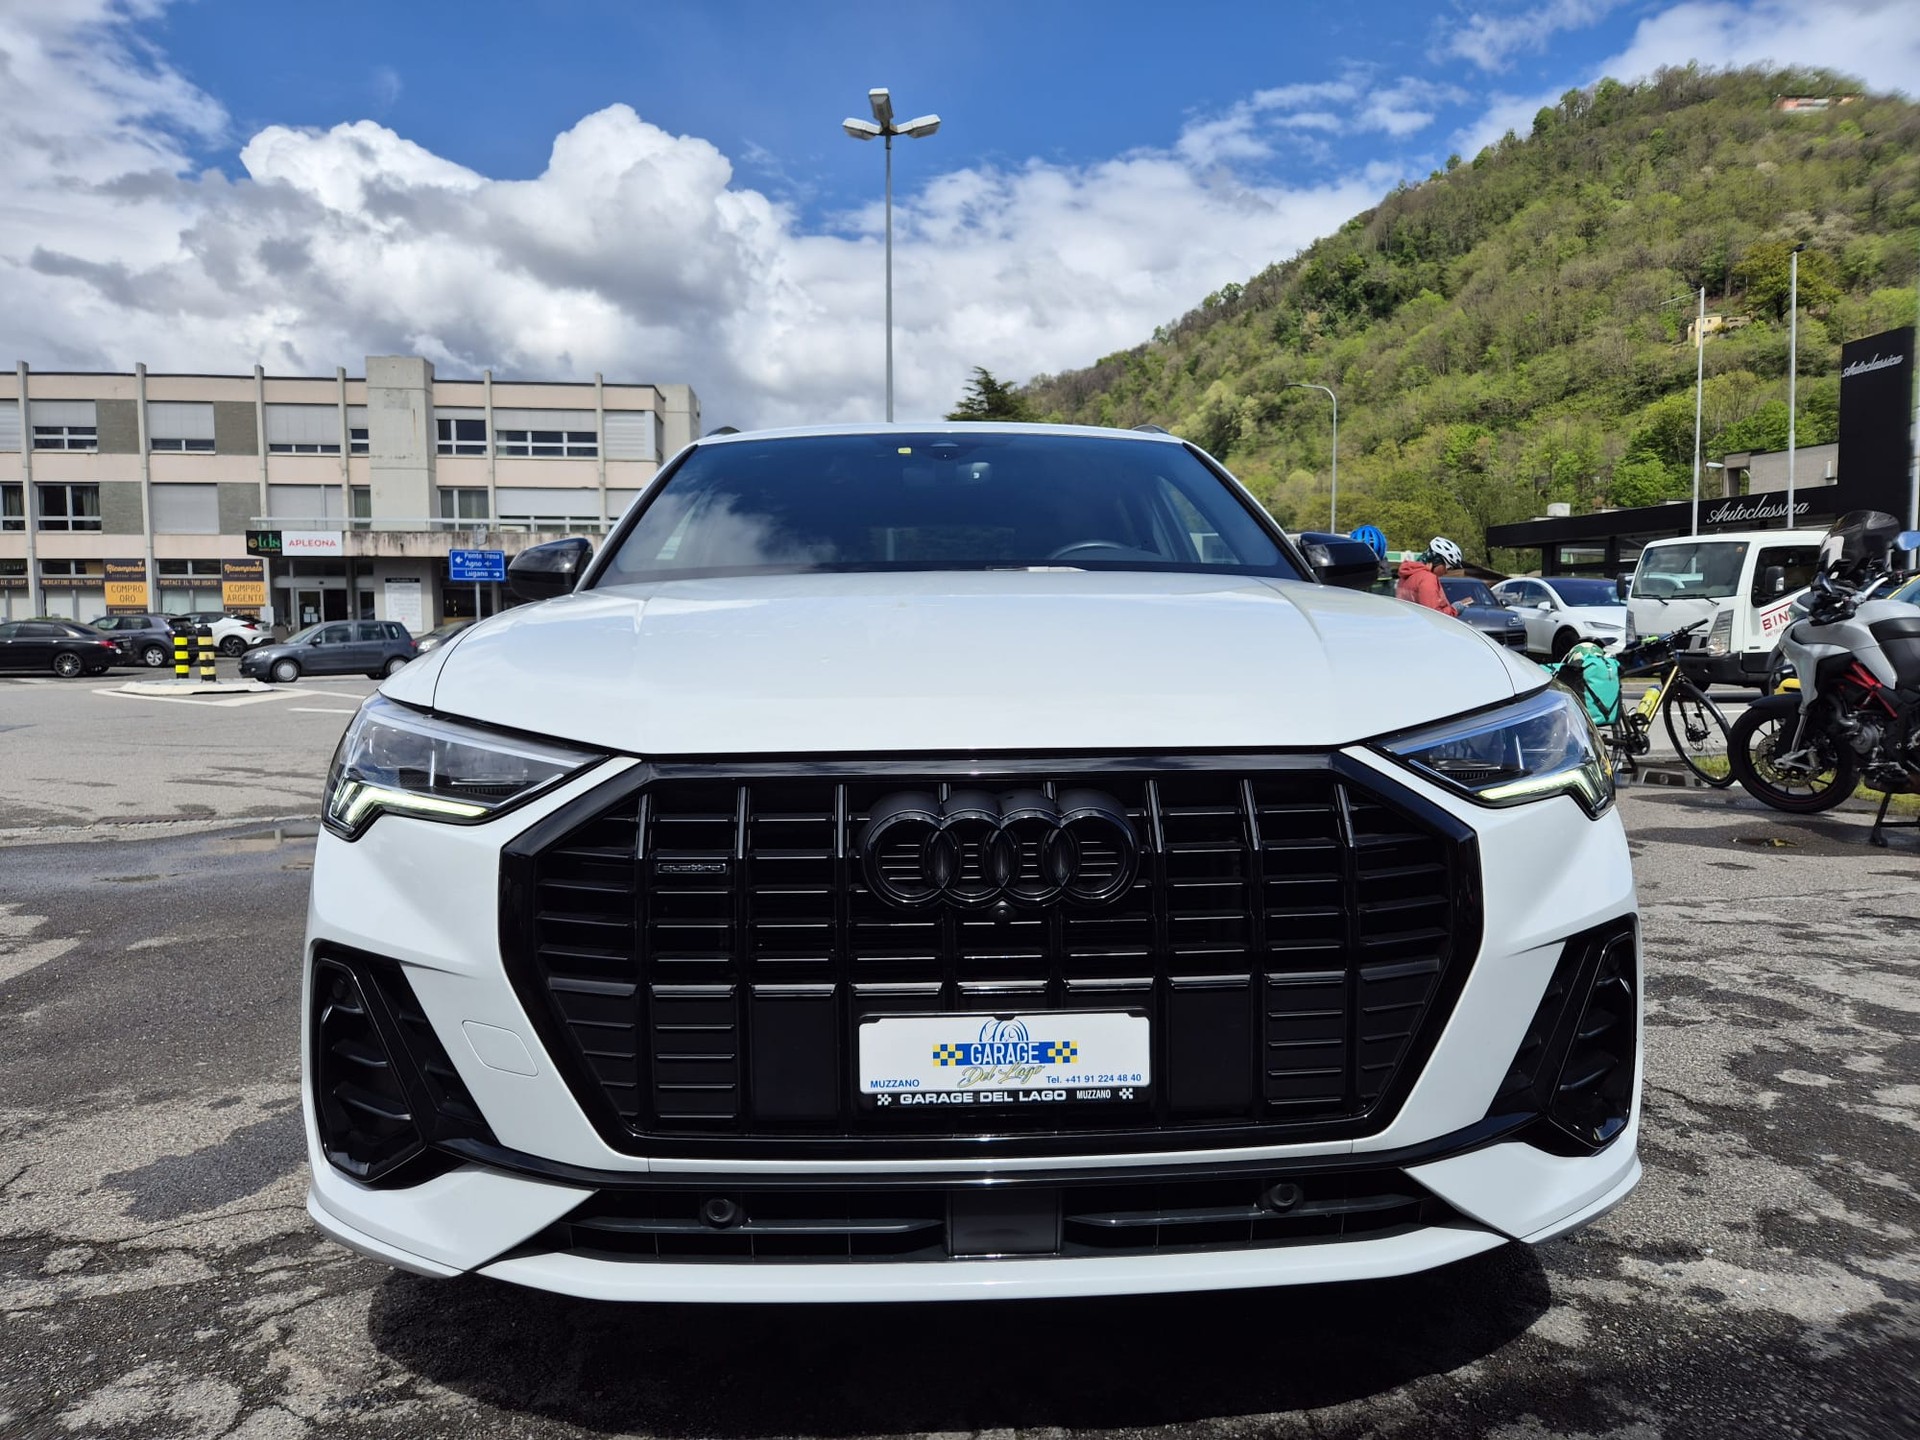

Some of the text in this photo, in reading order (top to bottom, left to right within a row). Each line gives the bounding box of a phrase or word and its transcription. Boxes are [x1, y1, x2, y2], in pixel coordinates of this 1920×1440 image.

[288, 539, 337, 547] APLEONA
[465, 570, 489, 578] Lugano
[110, 584, 144, 593] COMPRO
[228, 584, 261, 593] COMPRO
[119, 594, 136, 603] ORO
[226, 594, 264, 602] ARGENTO
[1762, 610, 1792, 630] BIN
[970, 1042, 1040, 1064] GARAGE
[957, 1061, 1045, 1088] Del Lago
[1046, 1073, 1142, 1084] Tel. +41 91 224 48 40
[870, 1079, 920, 1088] MUZZANO
[900, 1088, 1112, 1105] GARAGE DEL LAGO MUZZANO
